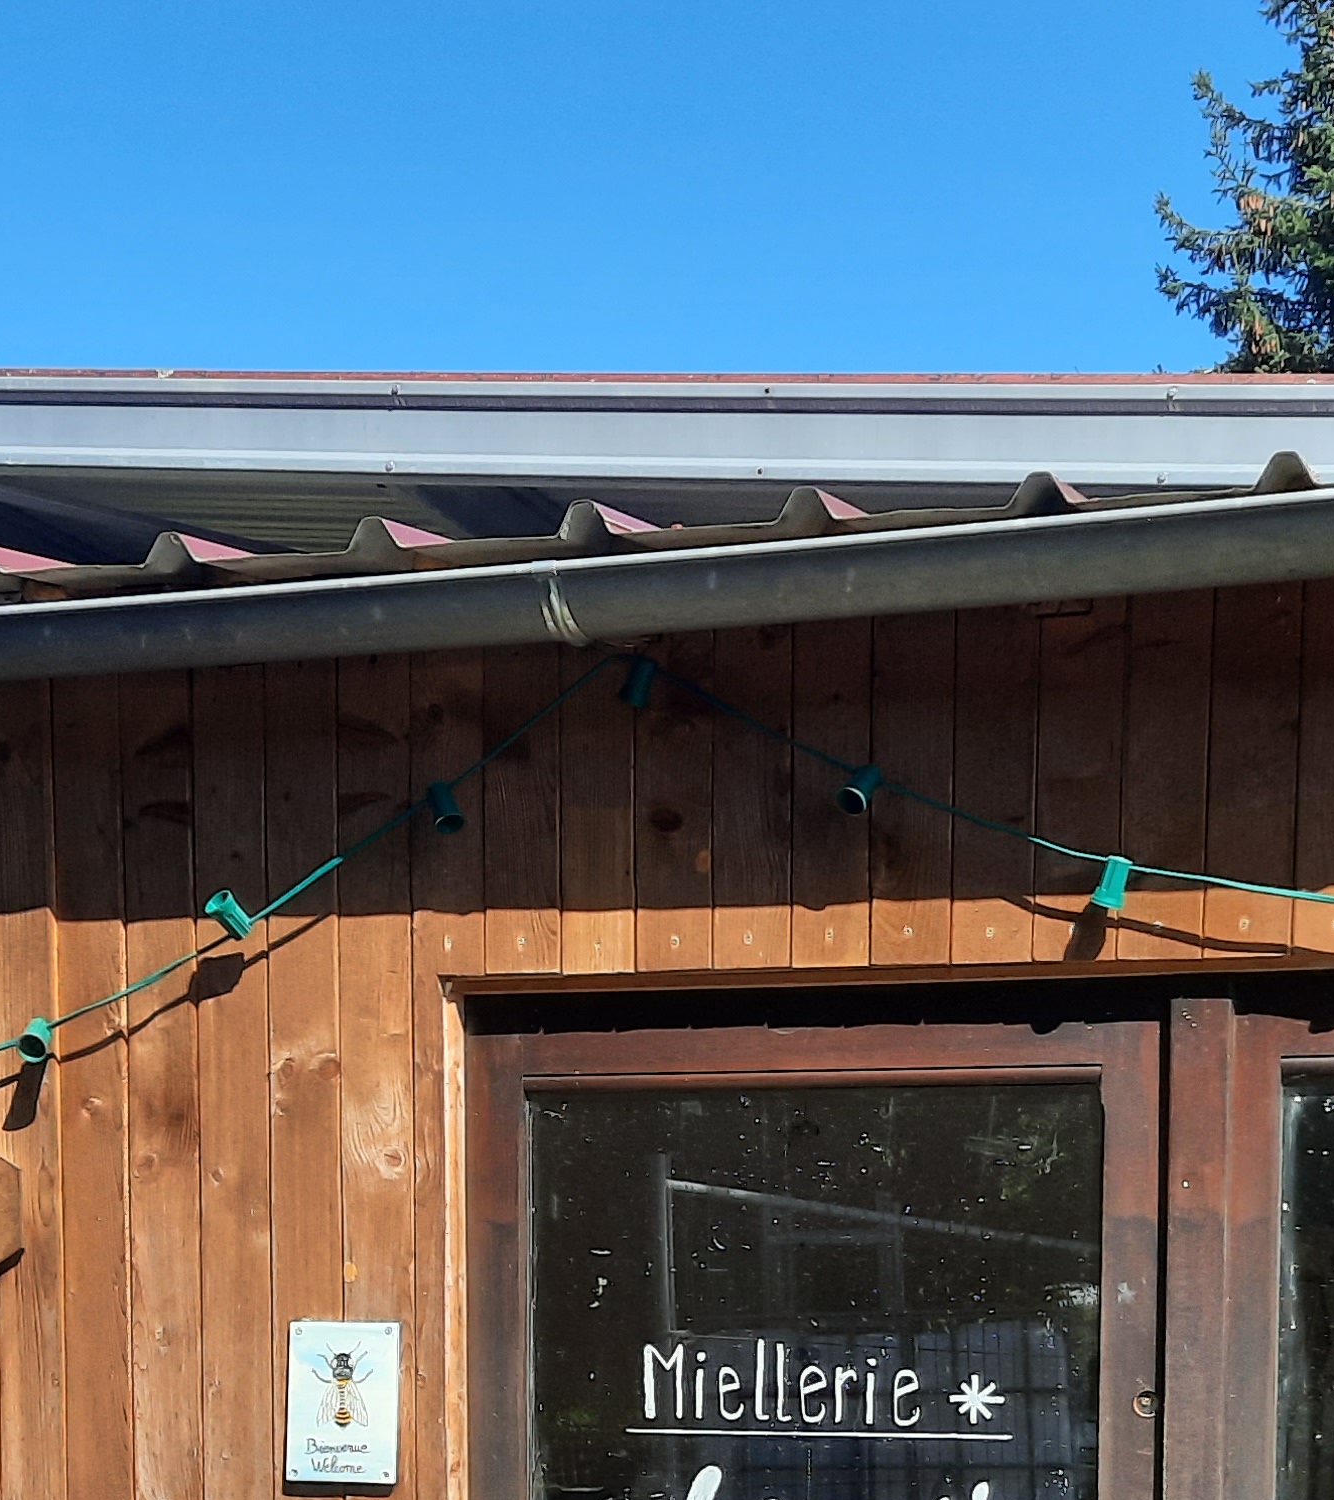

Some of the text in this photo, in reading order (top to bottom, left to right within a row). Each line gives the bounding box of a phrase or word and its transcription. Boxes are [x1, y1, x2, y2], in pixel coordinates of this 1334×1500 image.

[641, 1337, 922, 1428] Miellerie
[304, 1437, 371, 1455] Bienvenue
[310, 1455, 366, 1474] Welcome
